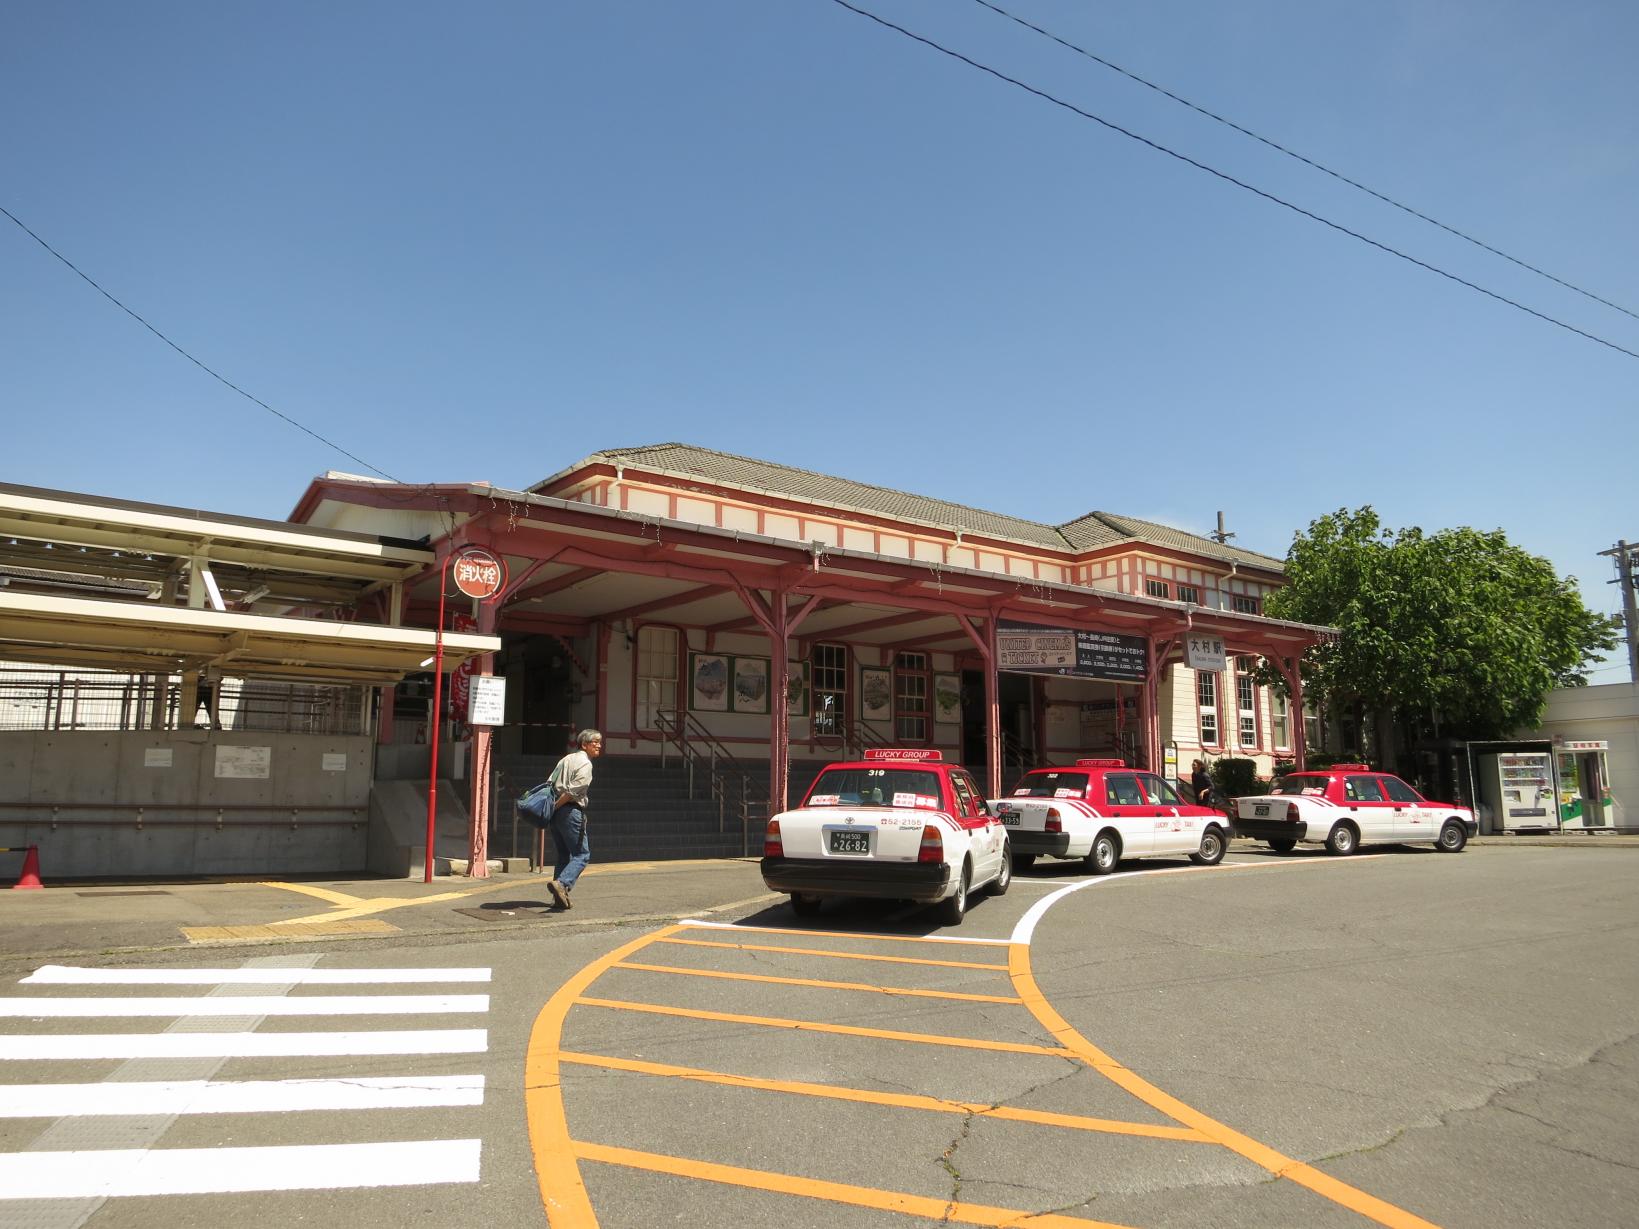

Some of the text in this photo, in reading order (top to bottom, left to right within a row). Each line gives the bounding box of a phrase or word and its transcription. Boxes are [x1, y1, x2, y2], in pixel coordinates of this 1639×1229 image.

[459, 563, 497, 585] 消火栓
[1000, 636, 1072, 651] UNITED CINEMAS
[1191, 639, 1222, 655] 大村駅
[1008, 651, 1039, 665] TICKET
[868, 769, 885, 777] 319
[839, 840, 867, 851] 26-82
